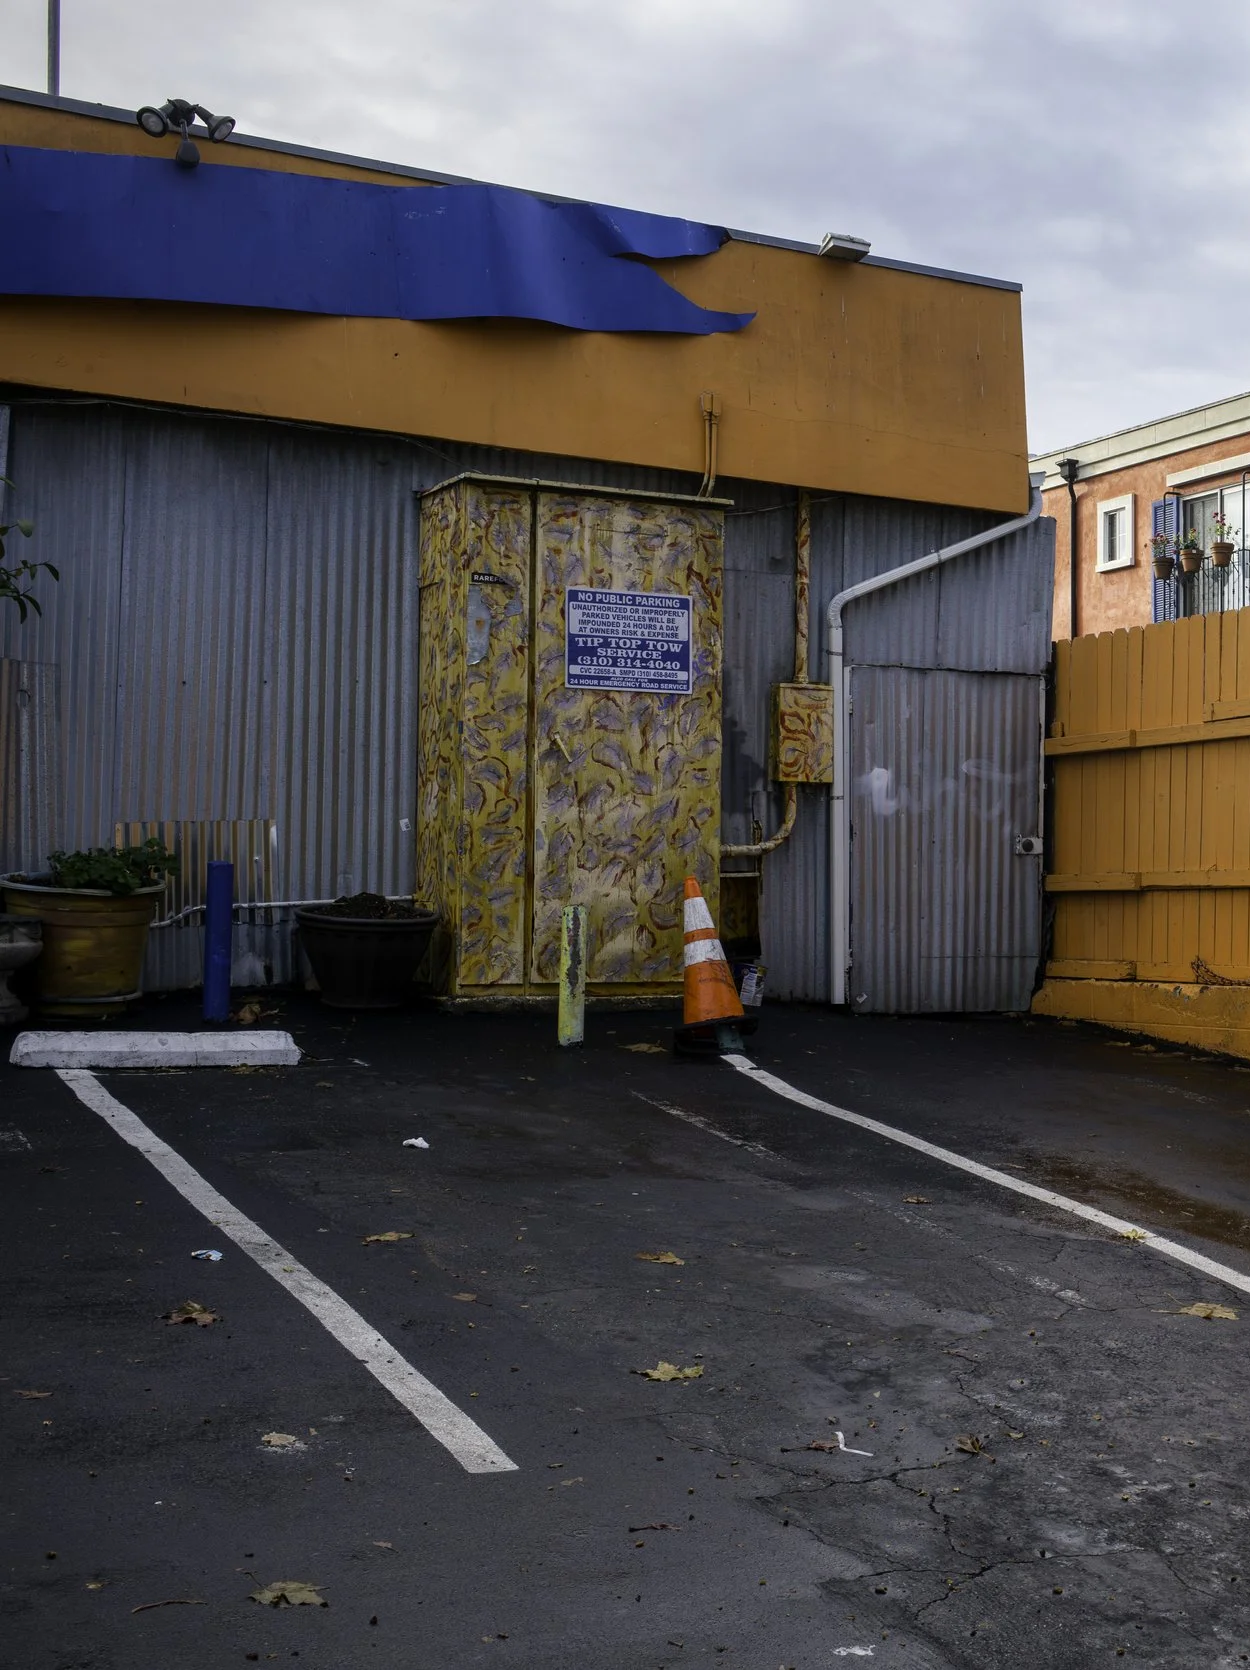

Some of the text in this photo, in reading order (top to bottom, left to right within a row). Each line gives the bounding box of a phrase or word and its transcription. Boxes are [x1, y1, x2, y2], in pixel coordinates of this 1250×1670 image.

[578, 592, 680, 608] NO PUBLIC PARKING
[572, 604, 627, 613] UNAUTHORIZED
[642, 609, 685, 618] IMPROPERLY
[579, 619, 620, 628] IMPOUNDED
[575, 638, 682, 652] TIP TOP TOW
[597, 648, 661, 659] SERVICE
[578, 656, 680, 670] (310) 314-4040
